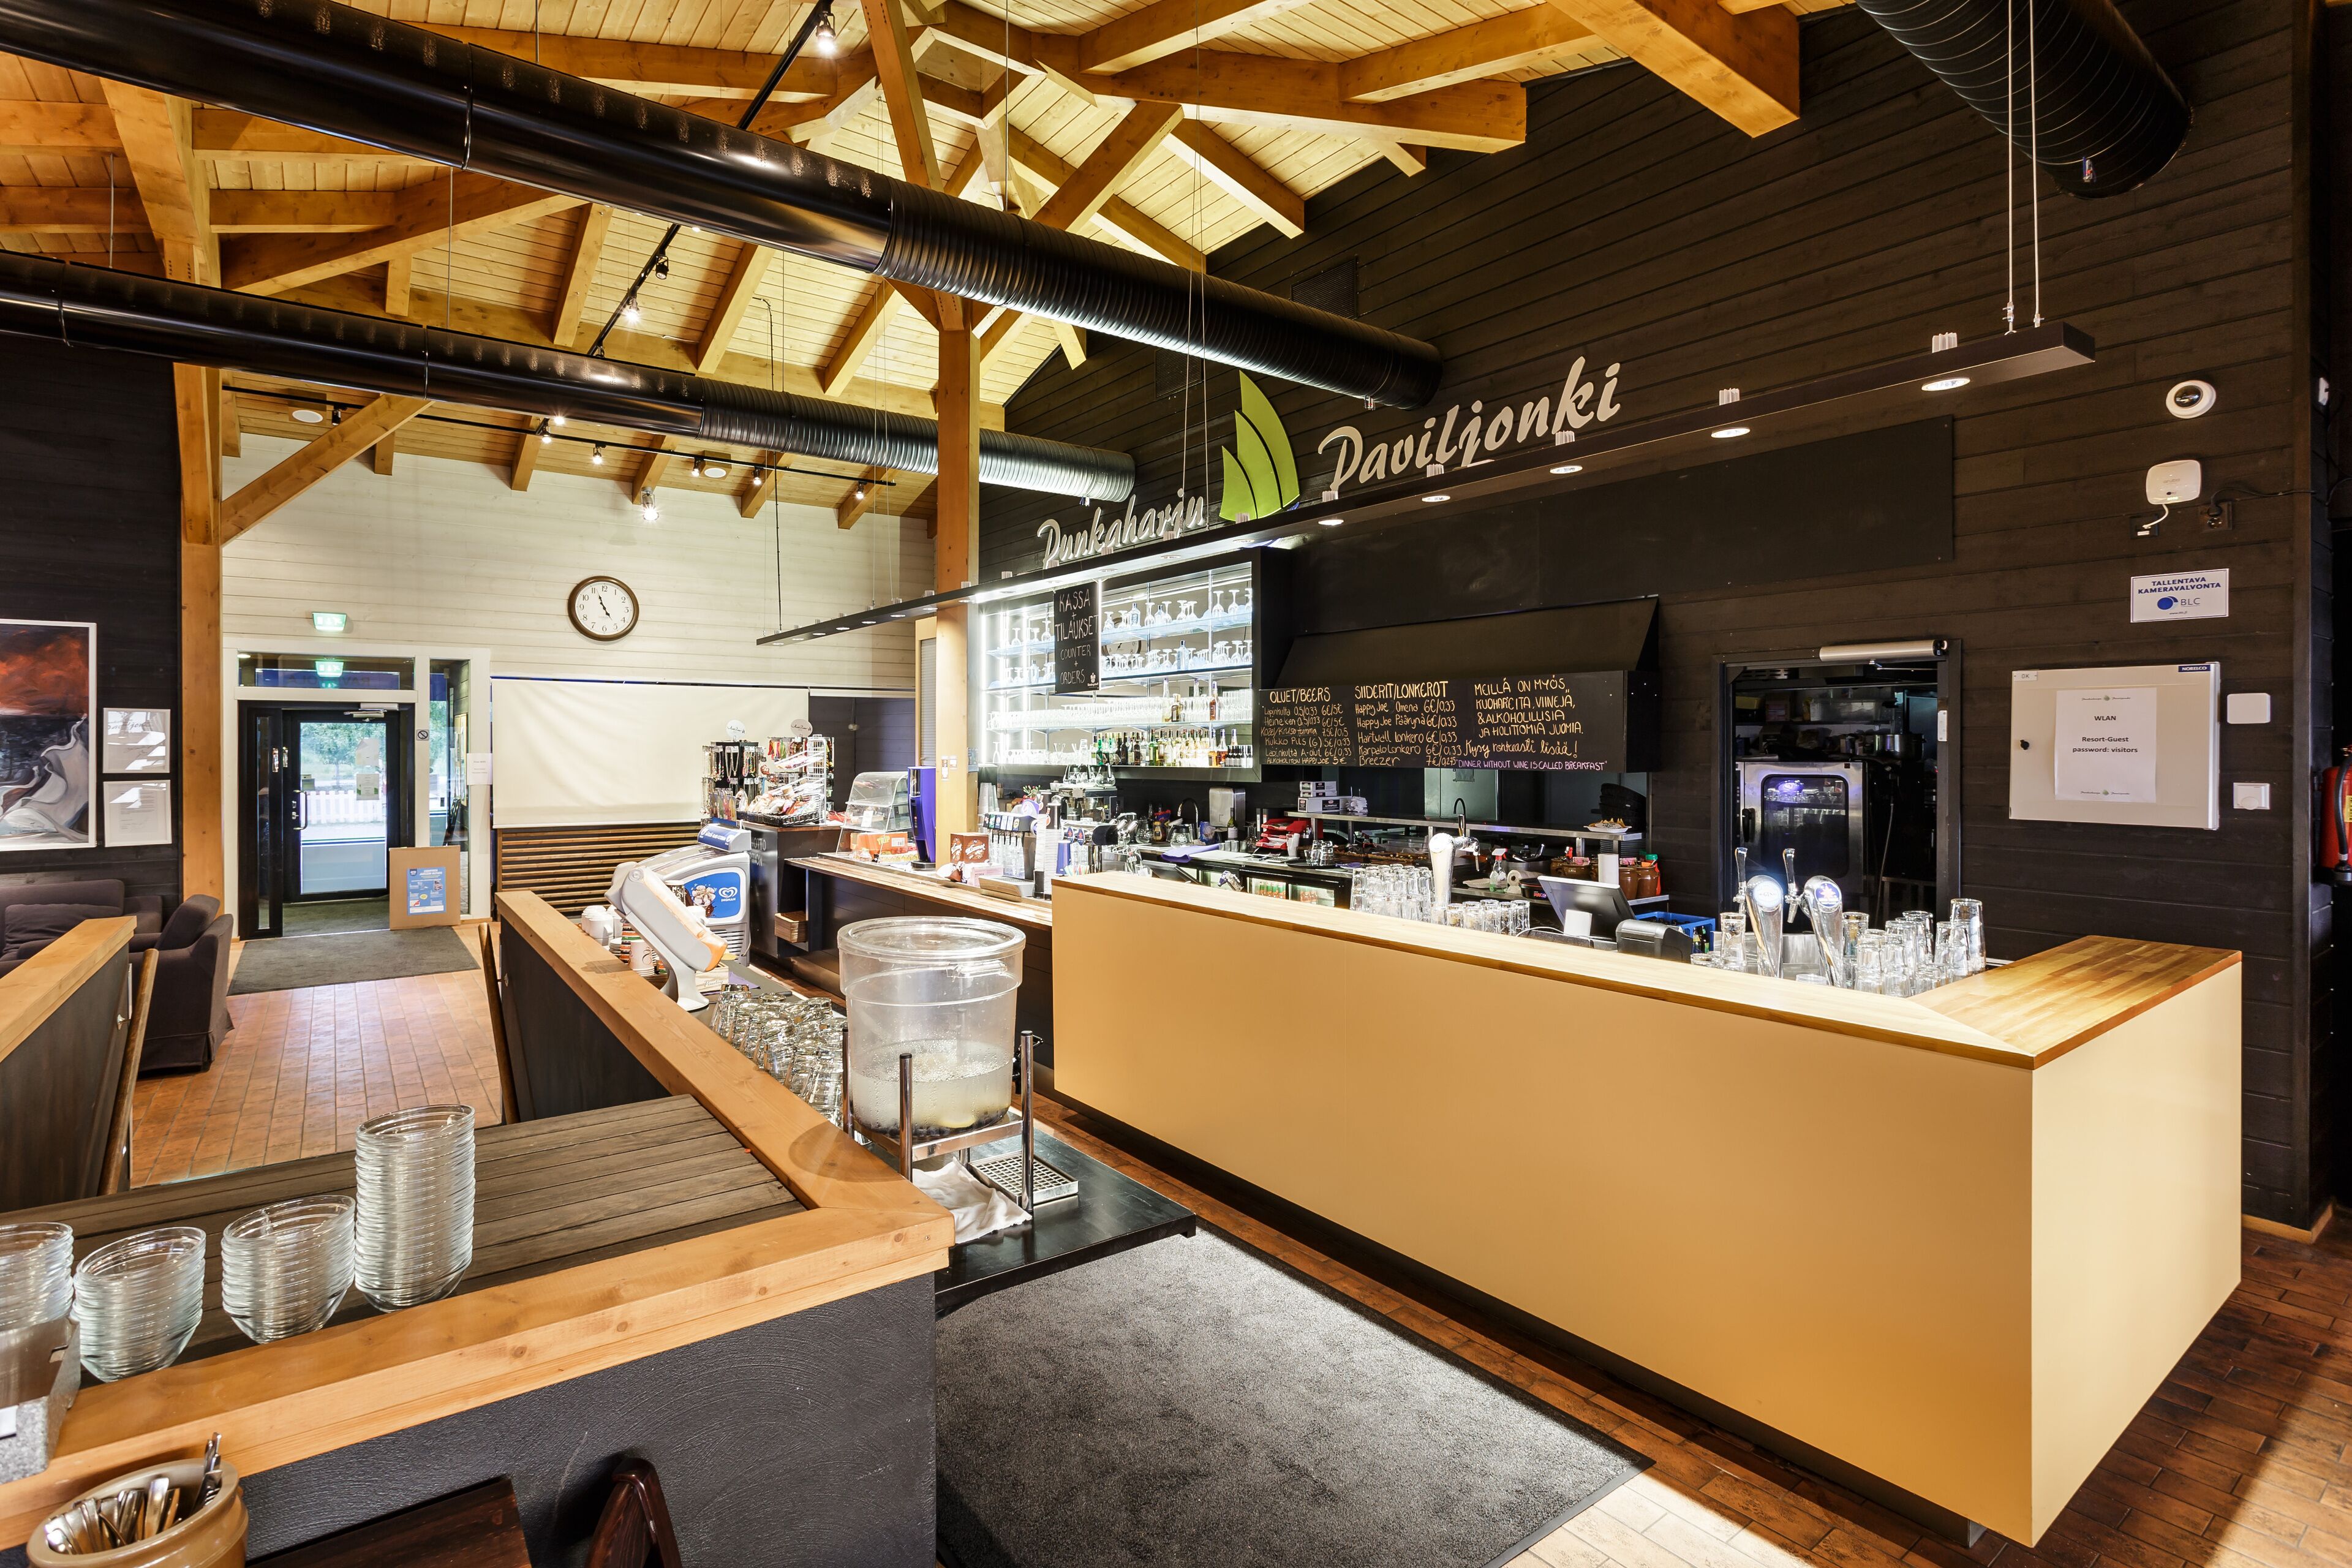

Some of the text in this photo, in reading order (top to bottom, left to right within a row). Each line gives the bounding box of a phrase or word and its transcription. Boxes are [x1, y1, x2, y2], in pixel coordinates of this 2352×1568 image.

[1318, 356, 1621, 491] Paviljonki
[1036, 488, 1204, 570] Punkaharju
[2138, 582, 2221, 594] KAMERAVALVONTA
[2152, 577, 2206, 586] TALLENTAVA
[1059, 589, 1090, 612] KASSA
[2180, 597, 2201, 606] BLC
[1055, 614, 1098, 642] TILAUKSET
[1060, 644, 1091, 660] COUNTER
[1060, 669, 1085, 685] ORDERS
[1355, 680, 1449, 700] SIIDERIT/LONKEROT
[1517, 680, 1531, 692] ON
[1270, 687, 1330, 704] OLUET/BEERS
[1355, 703, 1376, 716] Happy
[1377, 702, 1389, 712] Joe
[1395, 701, 1419, 712] Omena
[1357, 717, 1379, 730] Happy
[1380, 716, 1392, 726] Joe
[1358, 731, 1392, 744] Hartwall
[1479, 728, 1491, 739] JA
[1359, 756, 1400, 766] Breezer
[1483, 760, 1511, 769] WITHOUT
[1513, 761, 1529, 769] WINE
